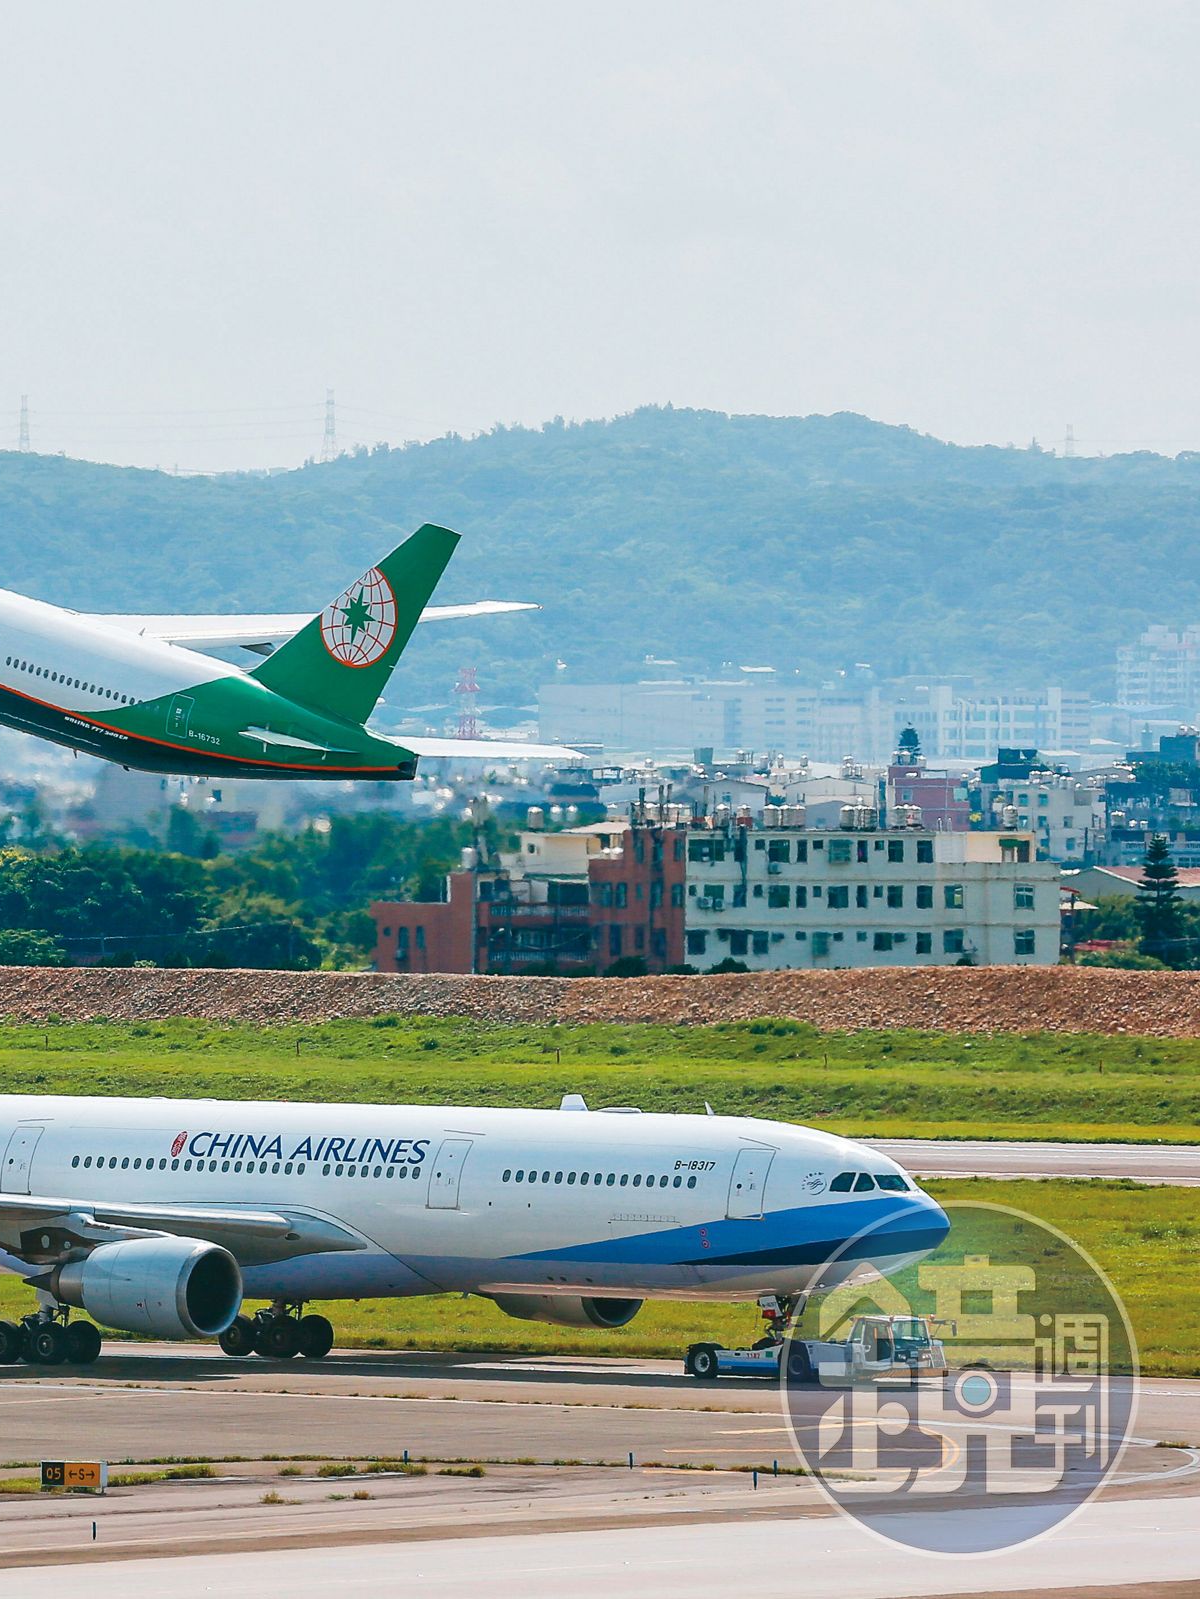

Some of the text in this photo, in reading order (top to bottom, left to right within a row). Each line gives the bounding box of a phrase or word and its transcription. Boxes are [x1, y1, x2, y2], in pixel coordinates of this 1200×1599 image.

[188, 729, 221, 746] B-16732
[188, 1132, 283, 1160] CHINA
[289, 1136, 431, 1165] AIRLINES
[673, 1160, 716, 1171] B-18317
